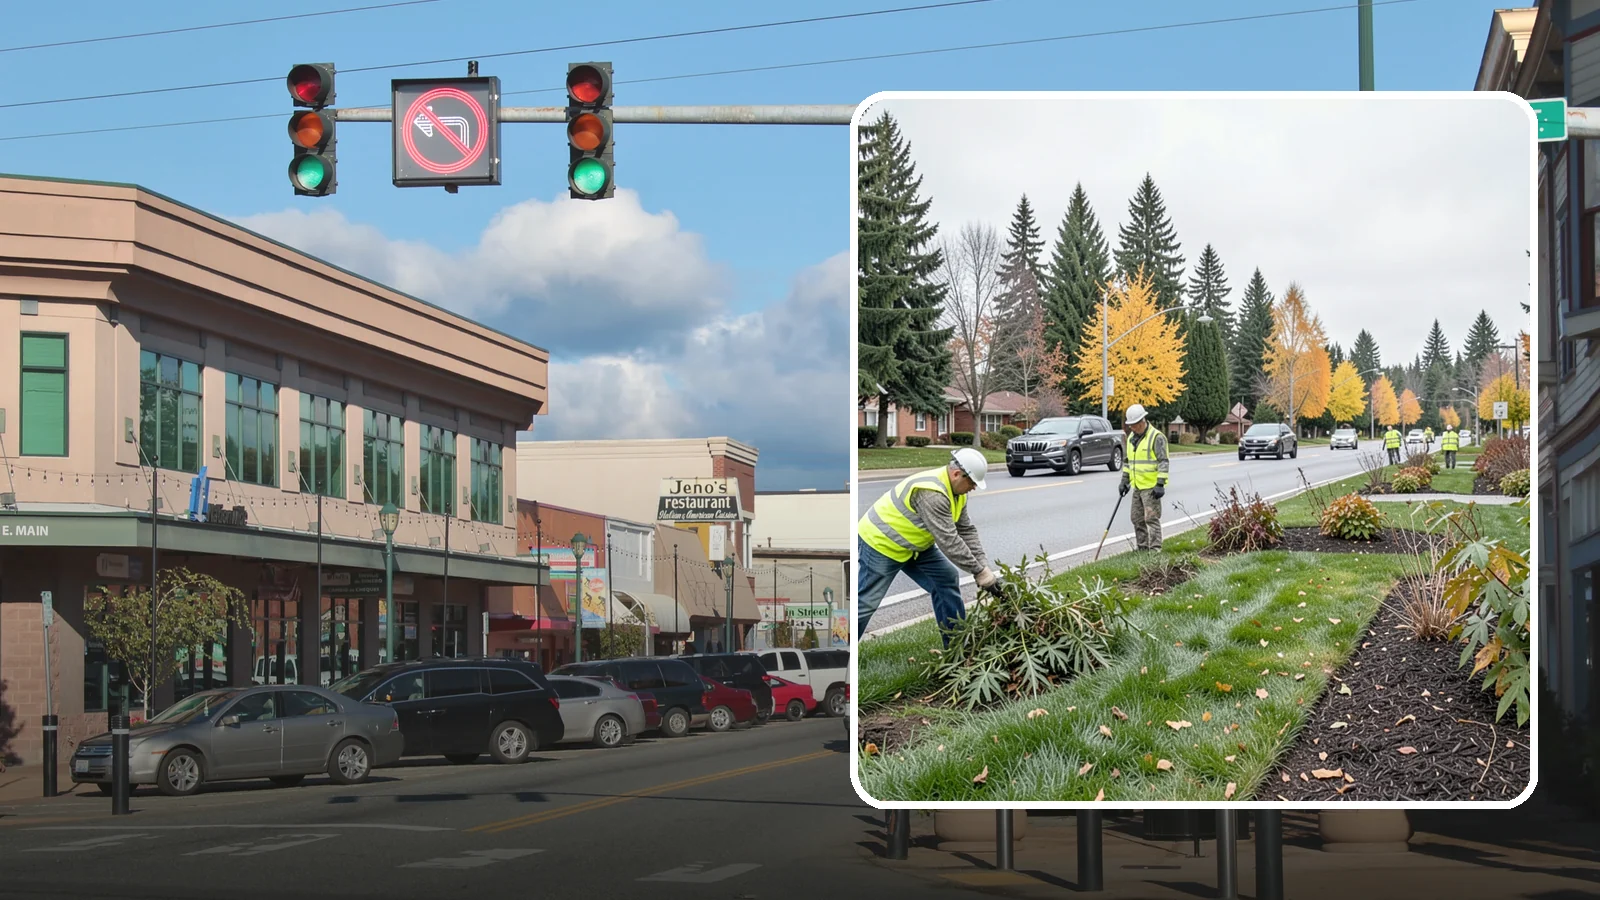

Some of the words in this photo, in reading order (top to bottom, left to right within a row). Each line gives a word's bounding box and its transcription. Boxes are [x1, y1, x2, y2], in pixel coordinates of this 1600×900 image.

[670, 480, 728, 494] Jeno's
[665, 496, 731, 509] restaurant
[686, 509, 714, 519] American
[715, 509, 738, 519] Cuisine
[2, 525, 13, 535] E.
[15, 525, 49, 536] MAIN
[797, 607, 828, 616] Street
